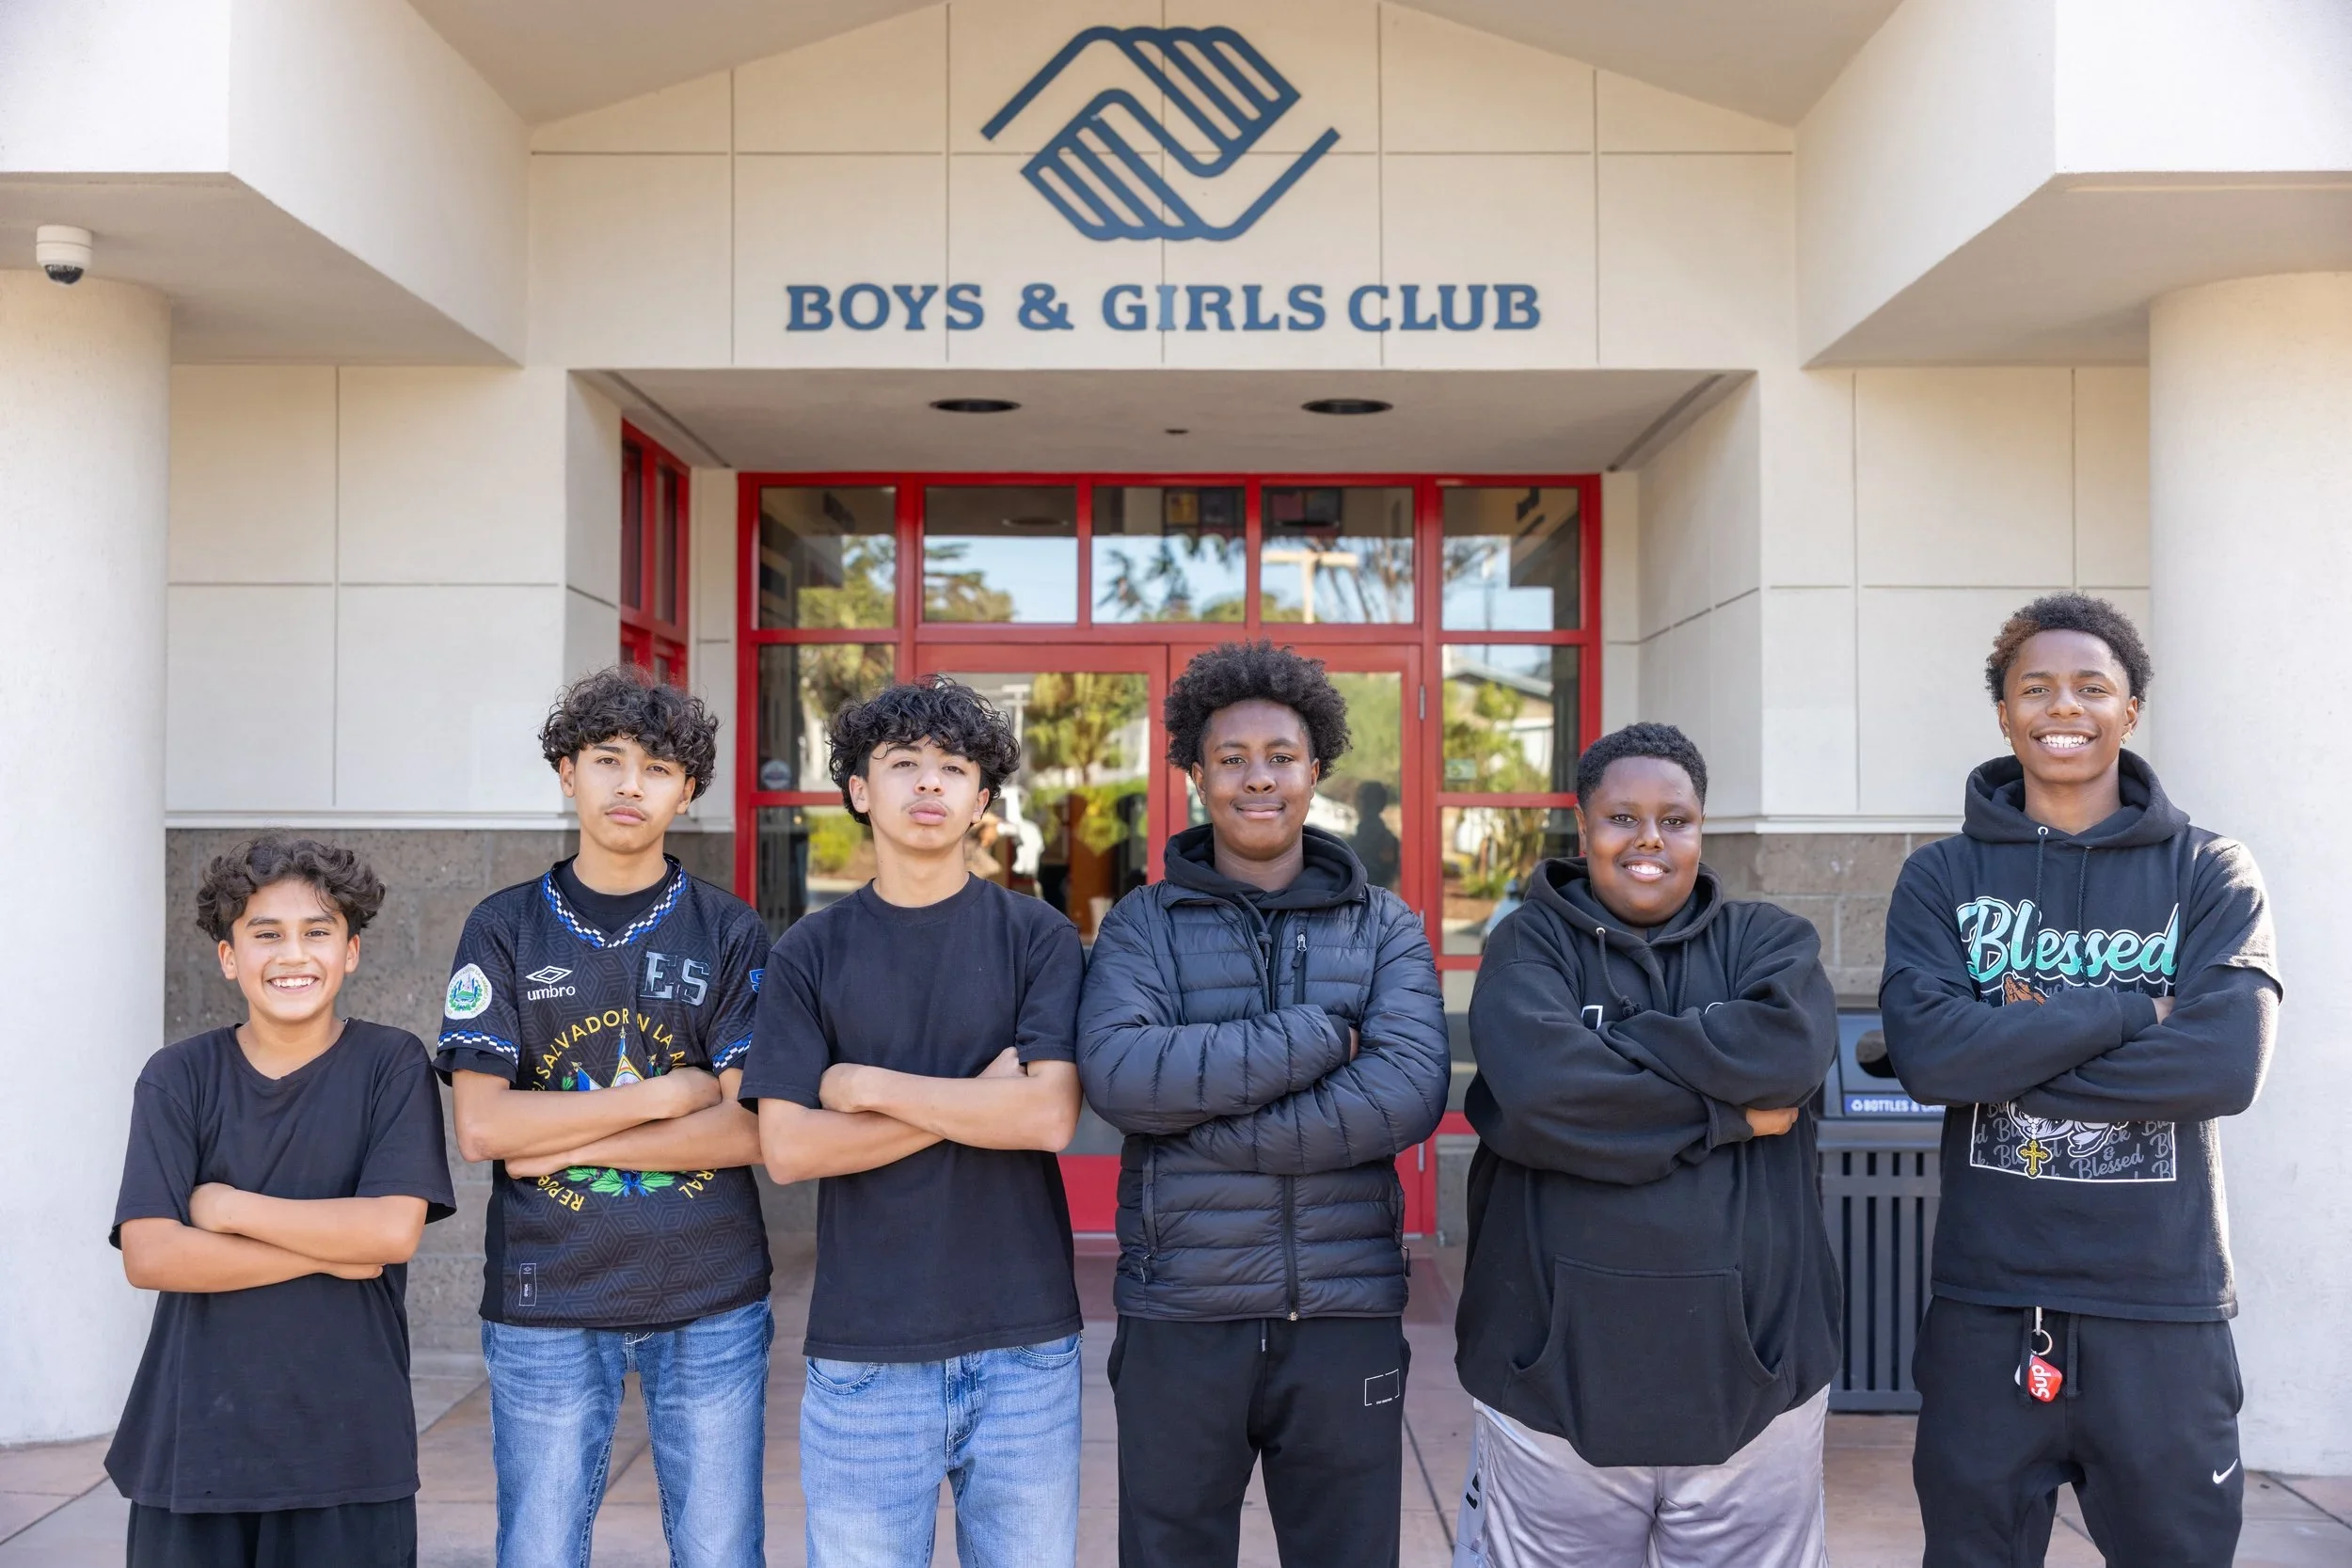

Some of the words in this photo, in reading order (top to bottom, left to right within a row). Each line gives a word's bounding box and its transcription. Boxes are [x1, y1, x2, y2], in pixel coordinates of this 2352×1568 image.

[787, 283, 984, 331] BOYS
[1017, 283, 1074, 331] &
[1102, 283, 1327, 331] GIRLS
[1347, 283, 1541, 331] CLUB
[1957, 896, 2180, 983] Blessed
[527, 984, 576, 1001] umbro
[639, 950, 708, 1006] ES
[535, 1008, 629, 1080] SALVADOR
[653, 1023, 674, 1050] LA
[1863, 1099, 1909, 1112] BOTTLES
[2069, 1143, 2145, 1180] Blessed
[2030, 1364, 2052, 1399] Sup
